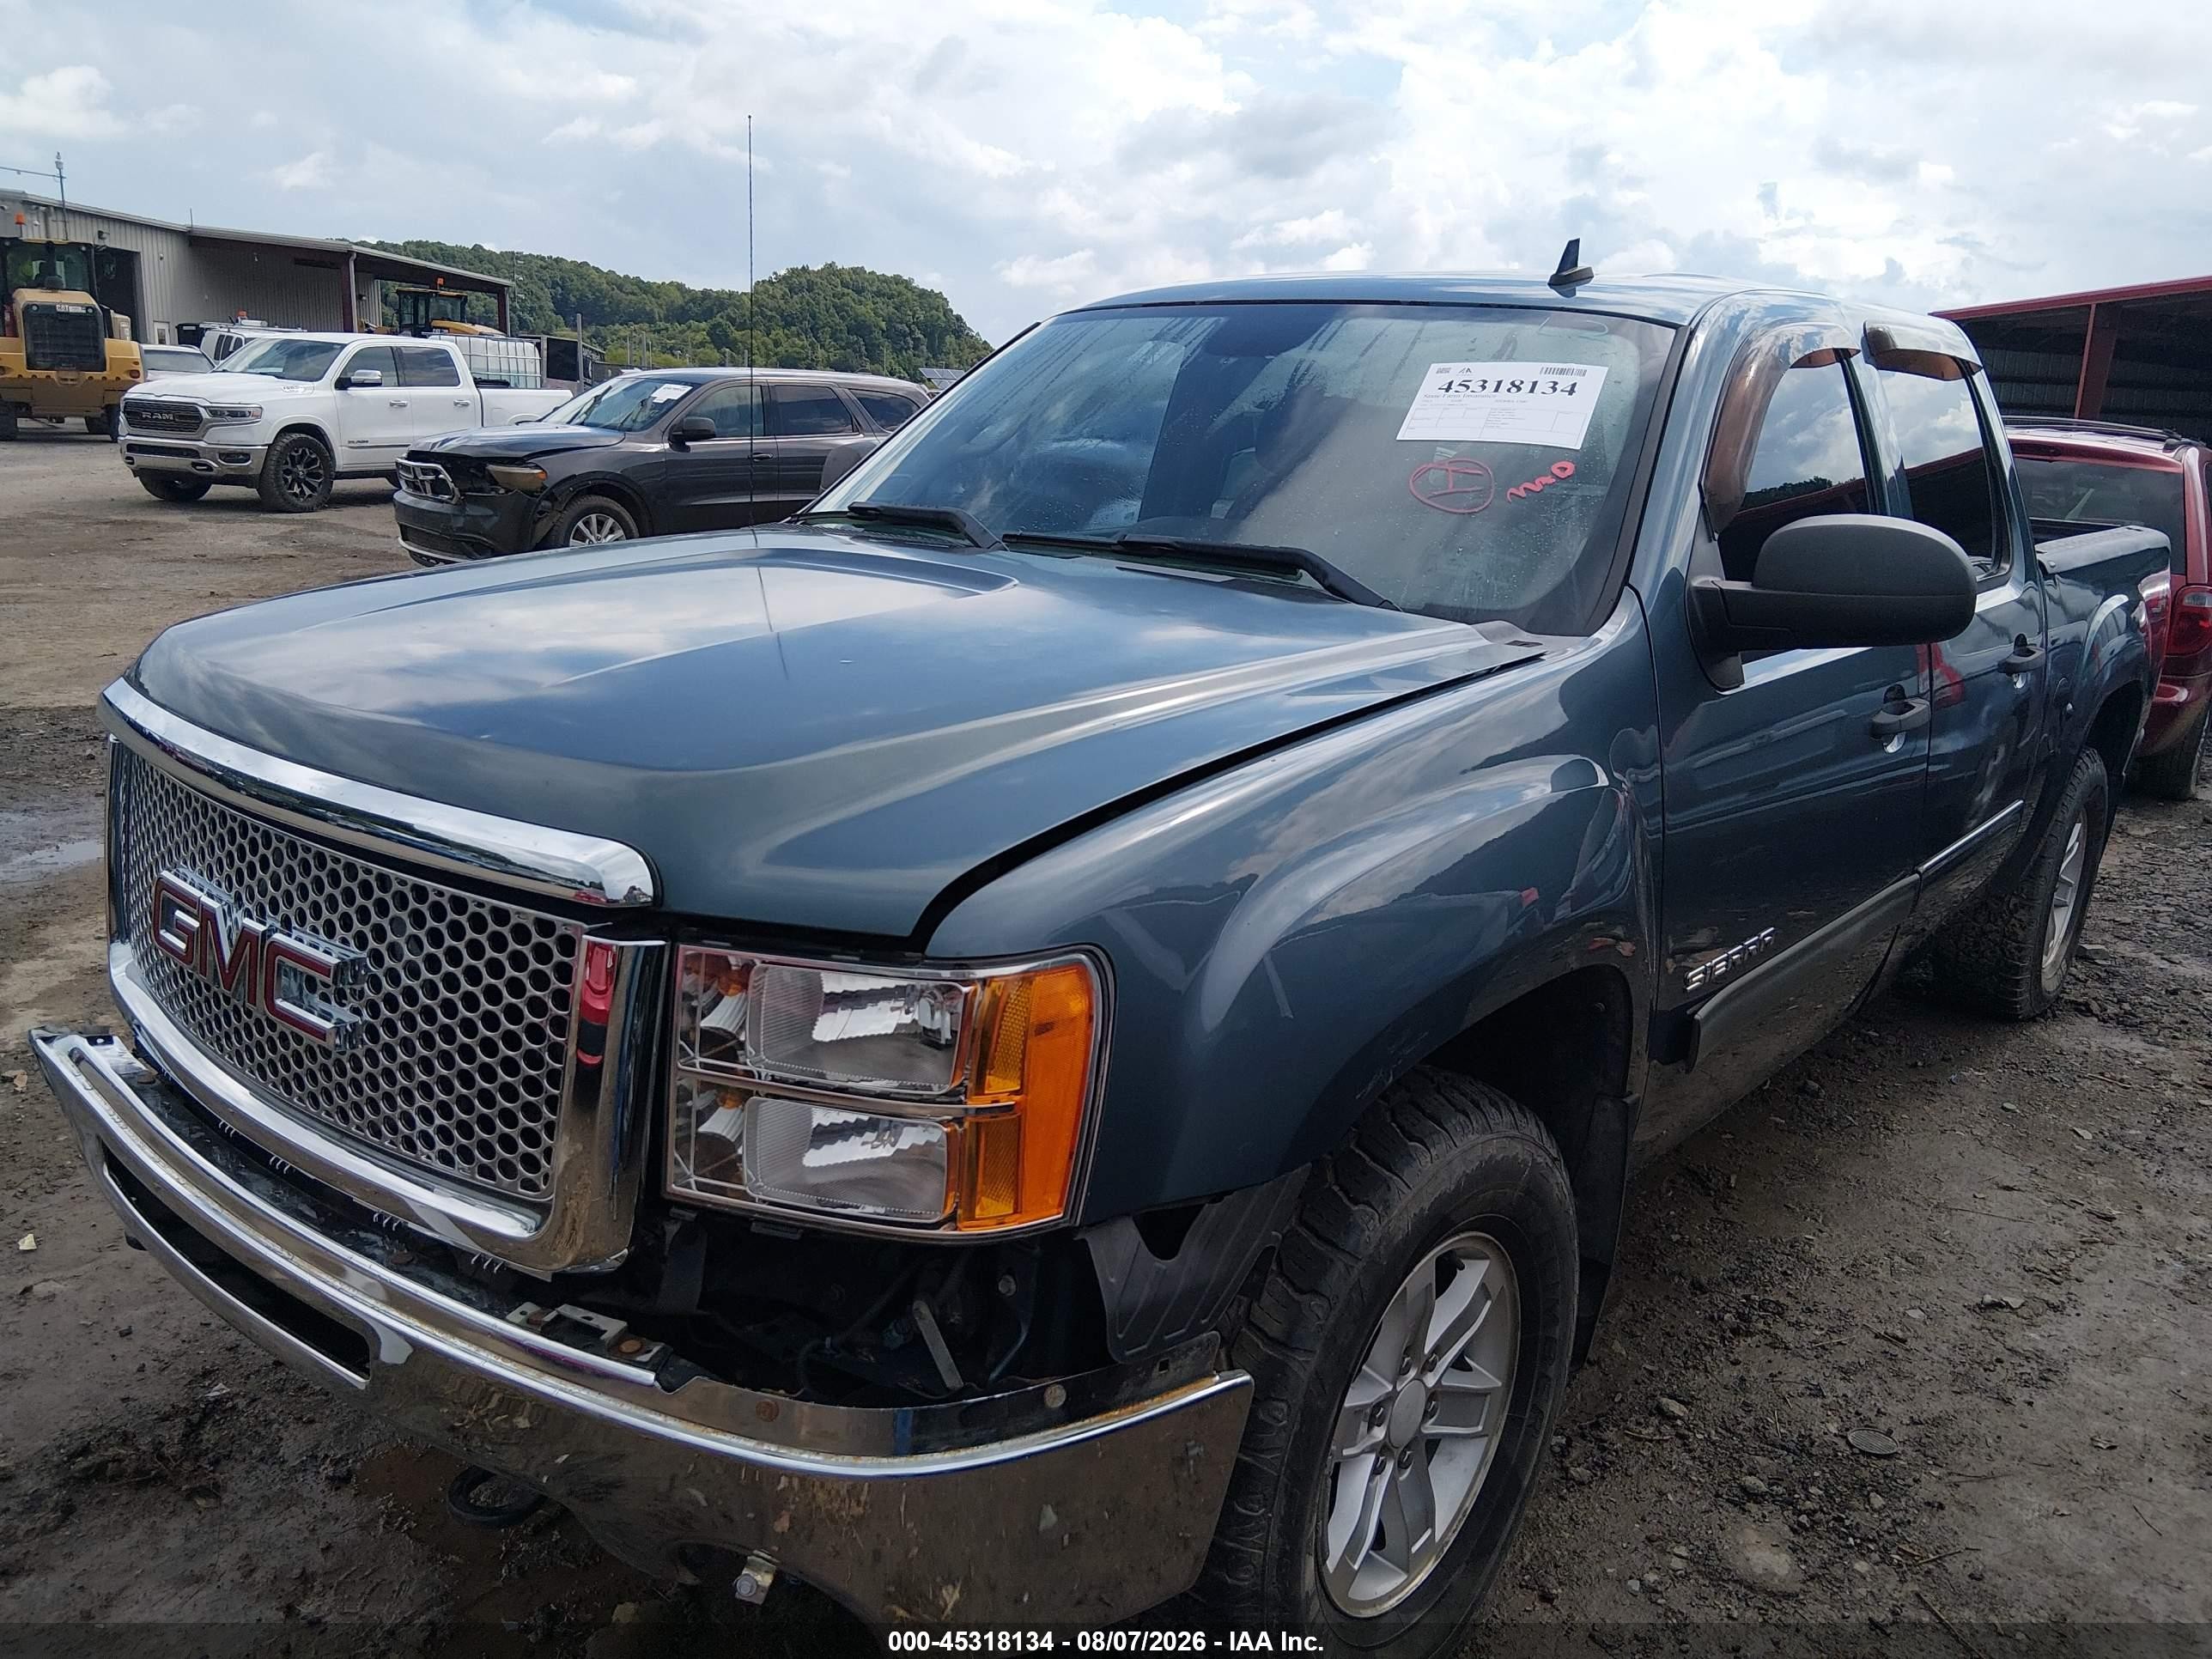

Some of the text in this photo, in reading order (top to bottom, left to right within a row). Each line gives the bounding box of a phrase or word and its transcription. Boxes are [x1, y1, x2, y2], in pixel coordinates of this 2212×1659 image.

[1437, 379, 1577, 397] 45318134
[152, 870, 347, 1048] GMC
[1684, 927, 1776, 991] SIERRA
